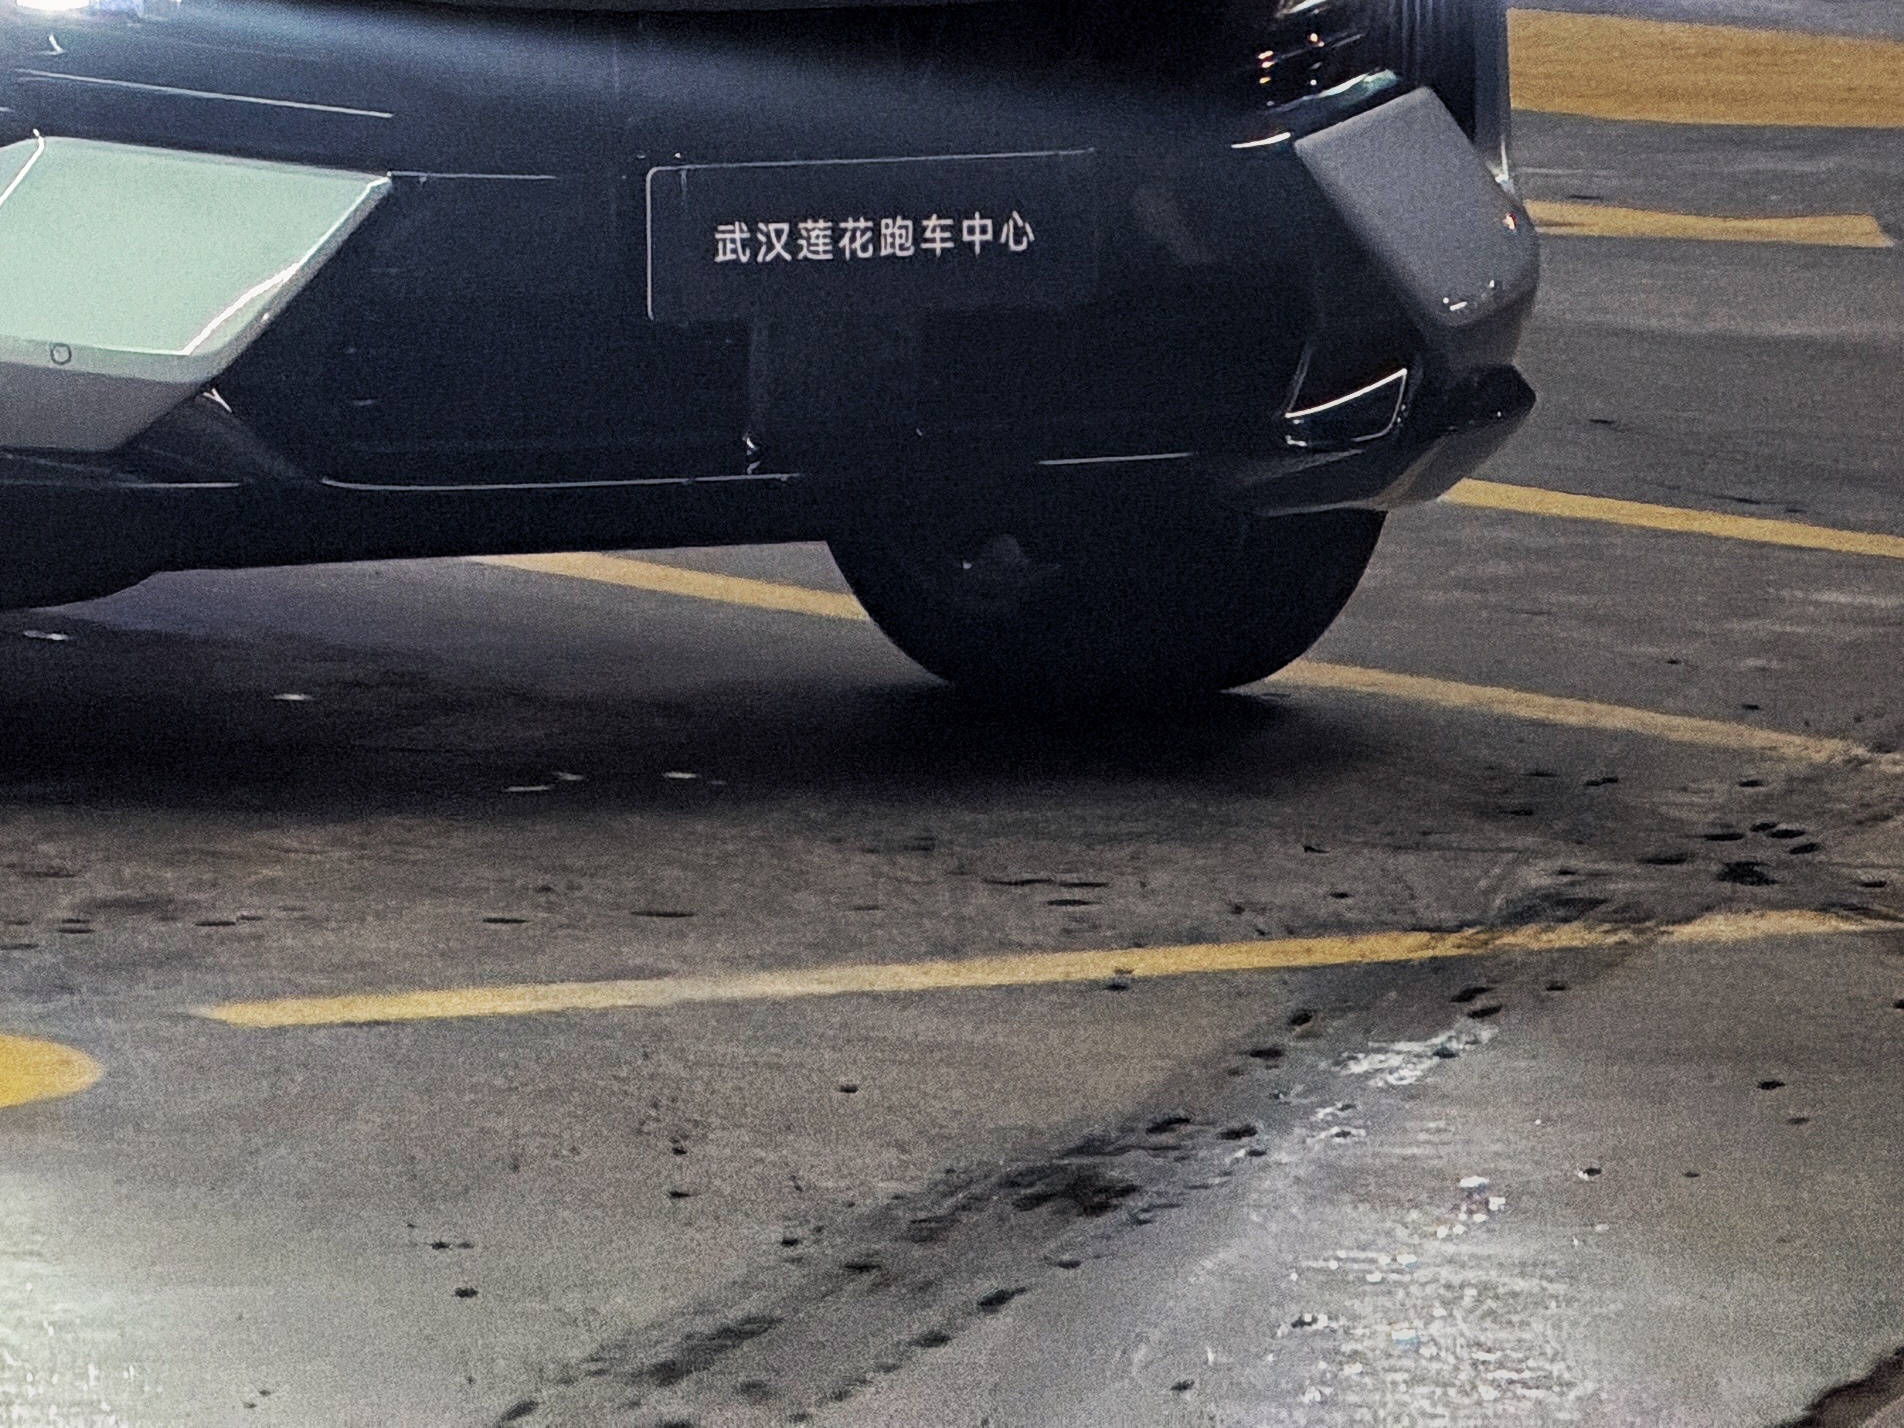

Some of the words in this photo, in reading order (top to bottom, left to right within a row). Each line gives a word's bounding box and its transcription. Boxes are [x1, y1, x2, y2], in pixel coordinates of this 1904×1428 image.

[713, 209, 1037, 265] 武汉莲花跑车中心
